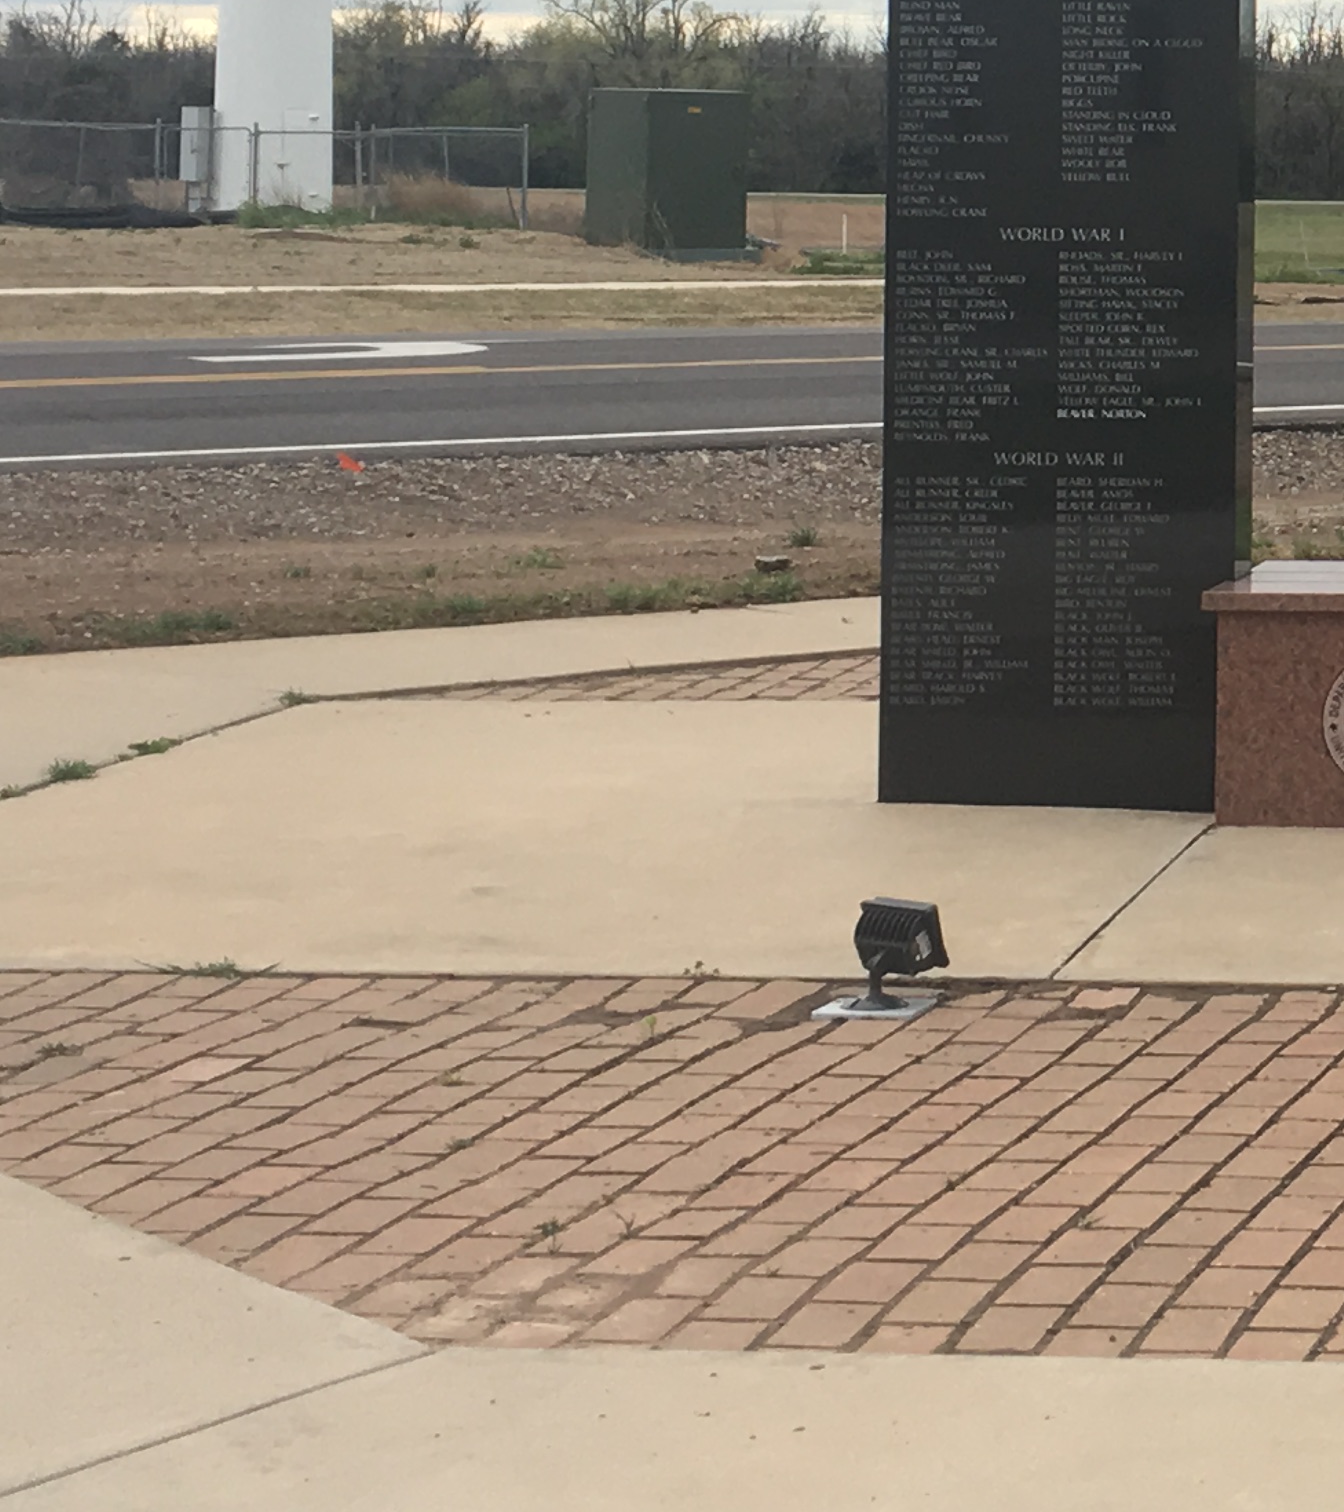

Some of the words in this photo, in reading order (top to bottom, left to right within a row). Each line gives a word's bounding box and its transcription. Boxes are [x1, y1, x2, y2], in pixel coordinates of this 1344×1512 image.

[1000, 227, 1064, 242] WORLD
[1071, 227, 1110, 242] WAR
[1118, 227, 1125, 242] I
[994, 452, 1058, 466] WORLD
[1066, 452, 1105, 466] WAR
[1112, 452, 1124, 466] II
